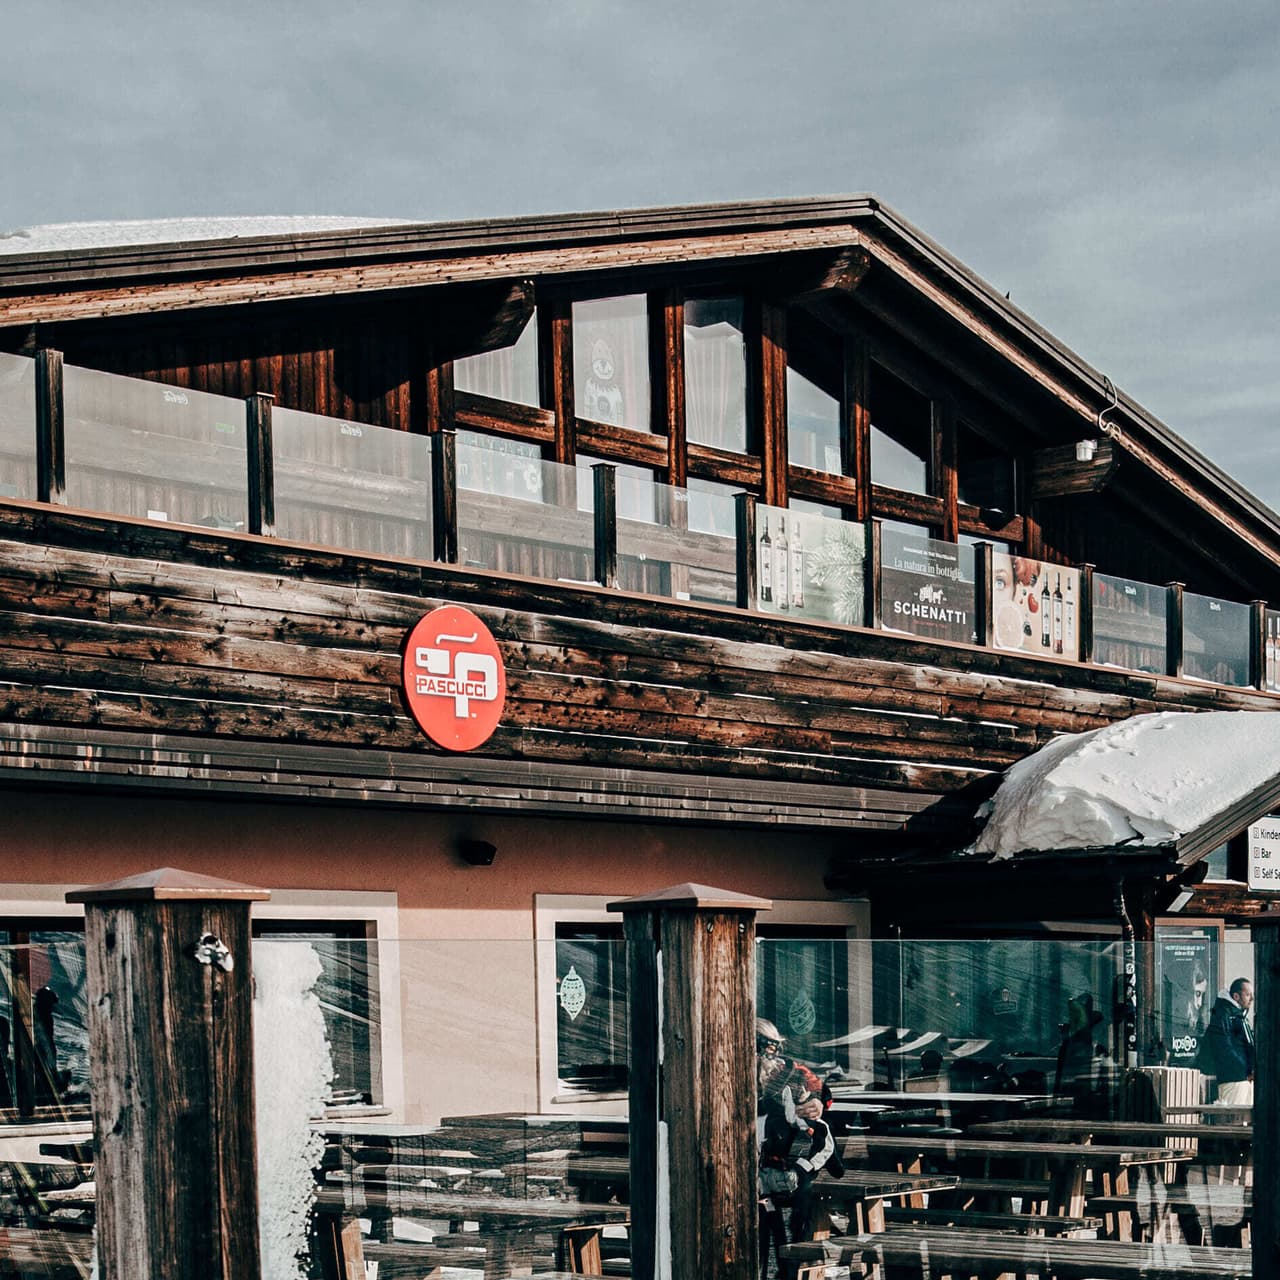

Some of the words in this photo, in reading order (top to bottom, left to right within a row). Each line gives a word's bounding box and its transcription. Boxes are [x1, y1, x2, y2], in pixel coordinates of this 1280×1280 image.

[893, 600, 966, 625] SCHENATTI
[417, 678, 487, 698] PASCUCCI
[1261, 848, 1271, 859] Bar
[1262, 868, 1273, 879] Self
